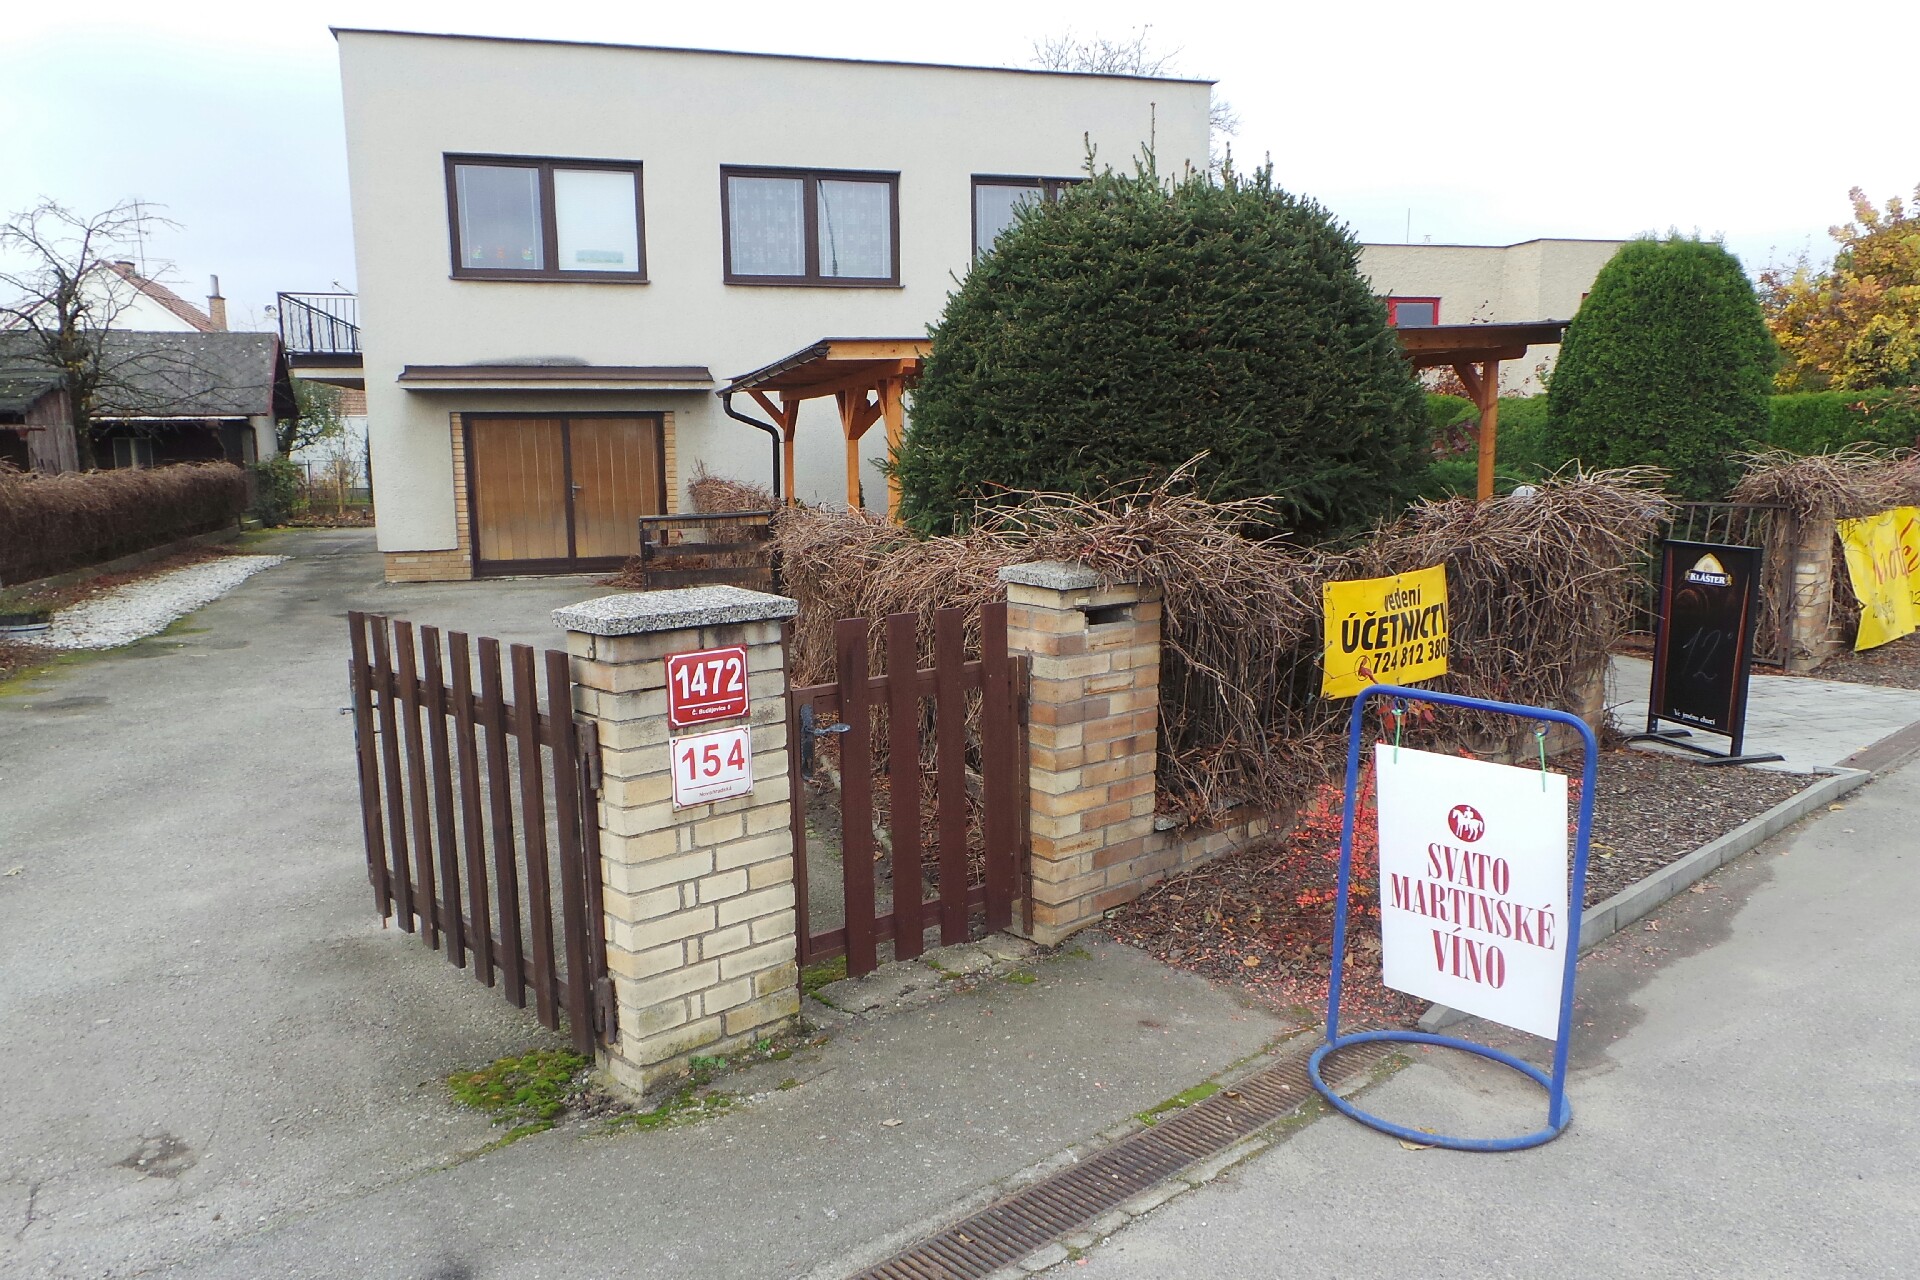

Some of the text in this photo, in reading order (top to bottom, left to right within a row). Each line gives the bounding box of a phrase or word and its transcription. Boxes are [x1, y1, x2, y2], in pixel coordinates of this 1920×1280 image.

[1384, 584, 1421, 612] vedení
[1373, 636, 1446, 675] 724 812 380
[675, 657, 743, 699] 1472
[681, 738, 745, 780] 154
[1428, 842, 1510, 896] SVATO
[1389, 872, 1556, 951] MARTINSKÉ
[1430, 926, 1506, 990] VÍNO
